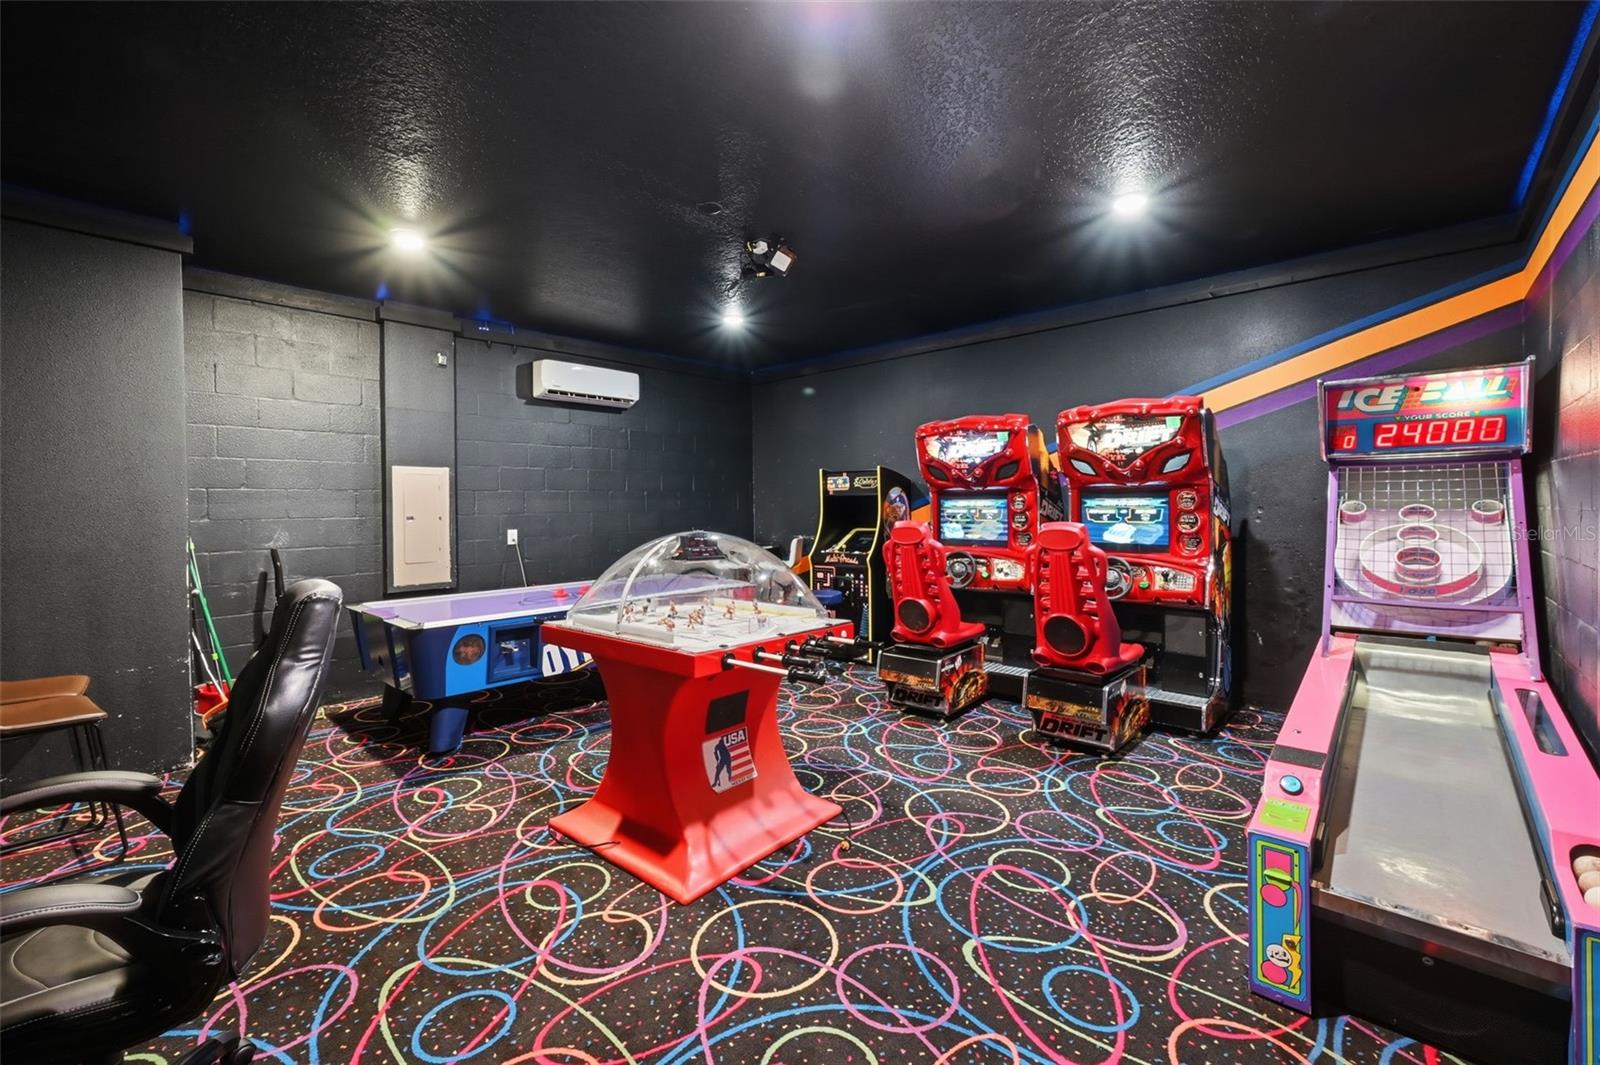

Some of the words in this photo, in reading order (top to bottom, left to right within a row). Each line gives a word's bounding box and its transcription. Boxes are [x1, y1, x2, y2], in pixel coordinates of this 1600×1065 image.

[1337, 386, 1408, 414] ICE
[1435, 411, 1471, 419] SCORE
[1376, 417, 1503, 447] 24000
[723, 729, 746, 747] USA
[1041, 717, 1108, 741] DRIFT
